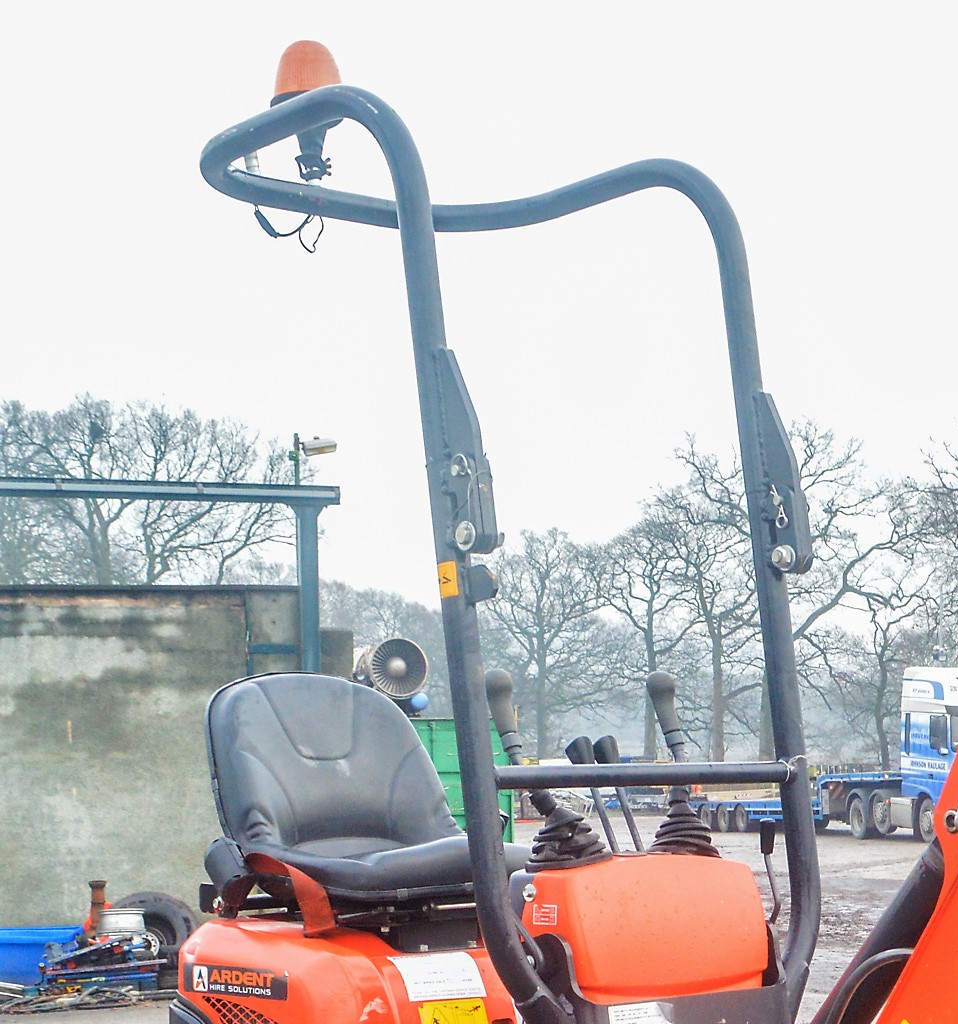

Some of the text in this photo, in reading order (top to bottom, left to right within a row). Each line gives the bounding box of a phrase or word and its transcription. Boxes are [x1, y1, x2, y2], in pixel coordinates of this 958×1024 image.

[210, 969, 273, 988] ARDENT
[209, 984, 272, 996] HIRE SOLUTIONS
